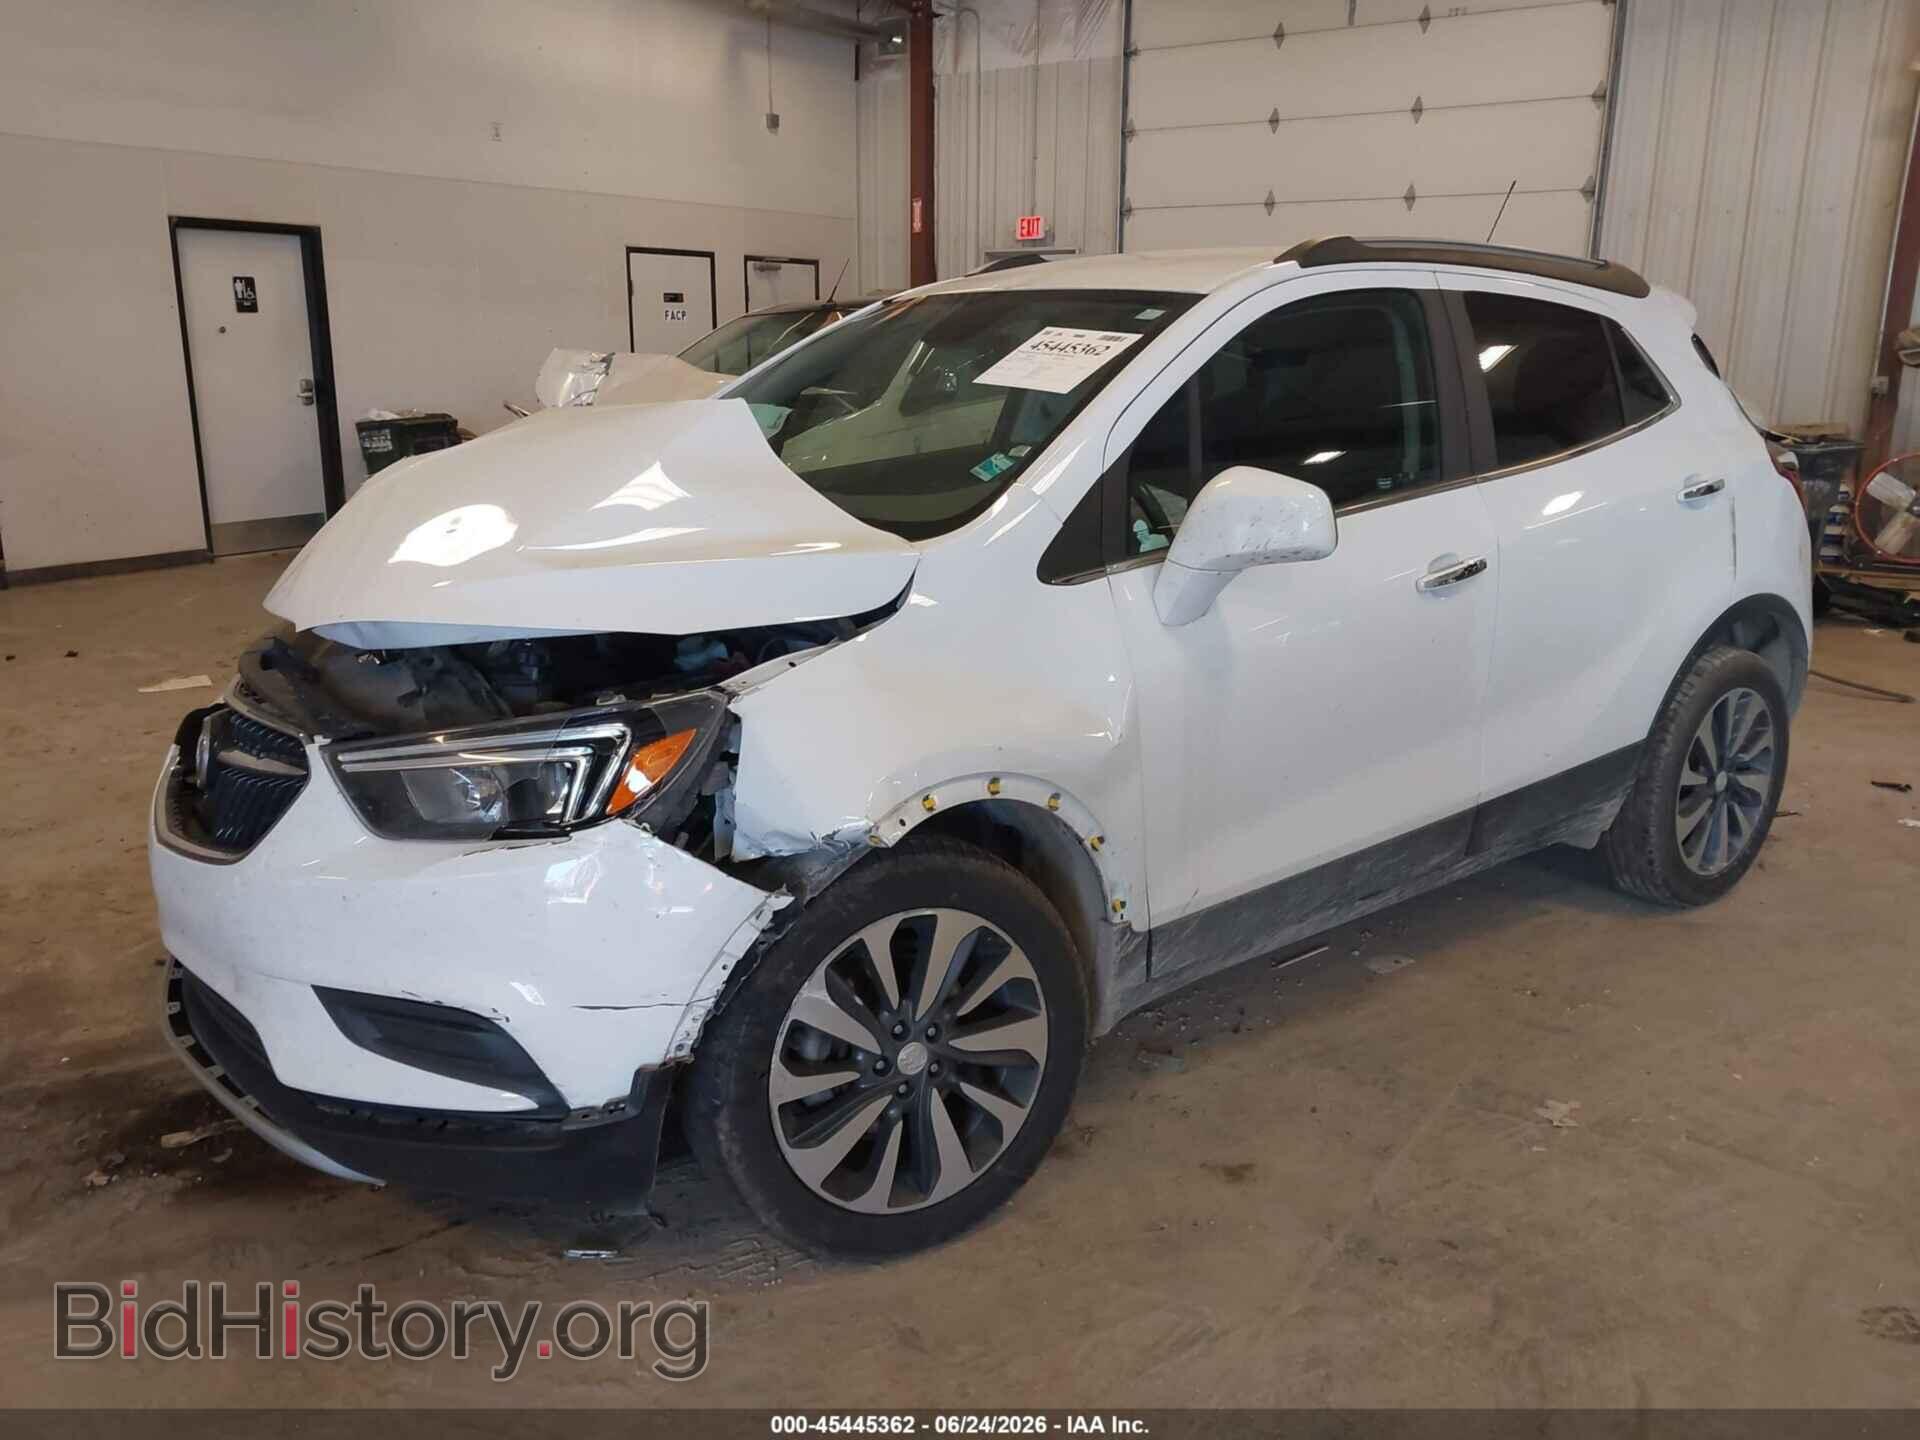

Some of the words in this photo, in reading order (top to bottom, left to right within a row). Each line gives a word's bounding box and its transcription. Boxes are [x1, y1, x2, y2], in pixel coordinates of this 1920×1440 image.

[1020, 217, 1041, 237] EXIT
[664, 309, 687, 321] FACP
[1030, 340, 1112, 356] 45445362
